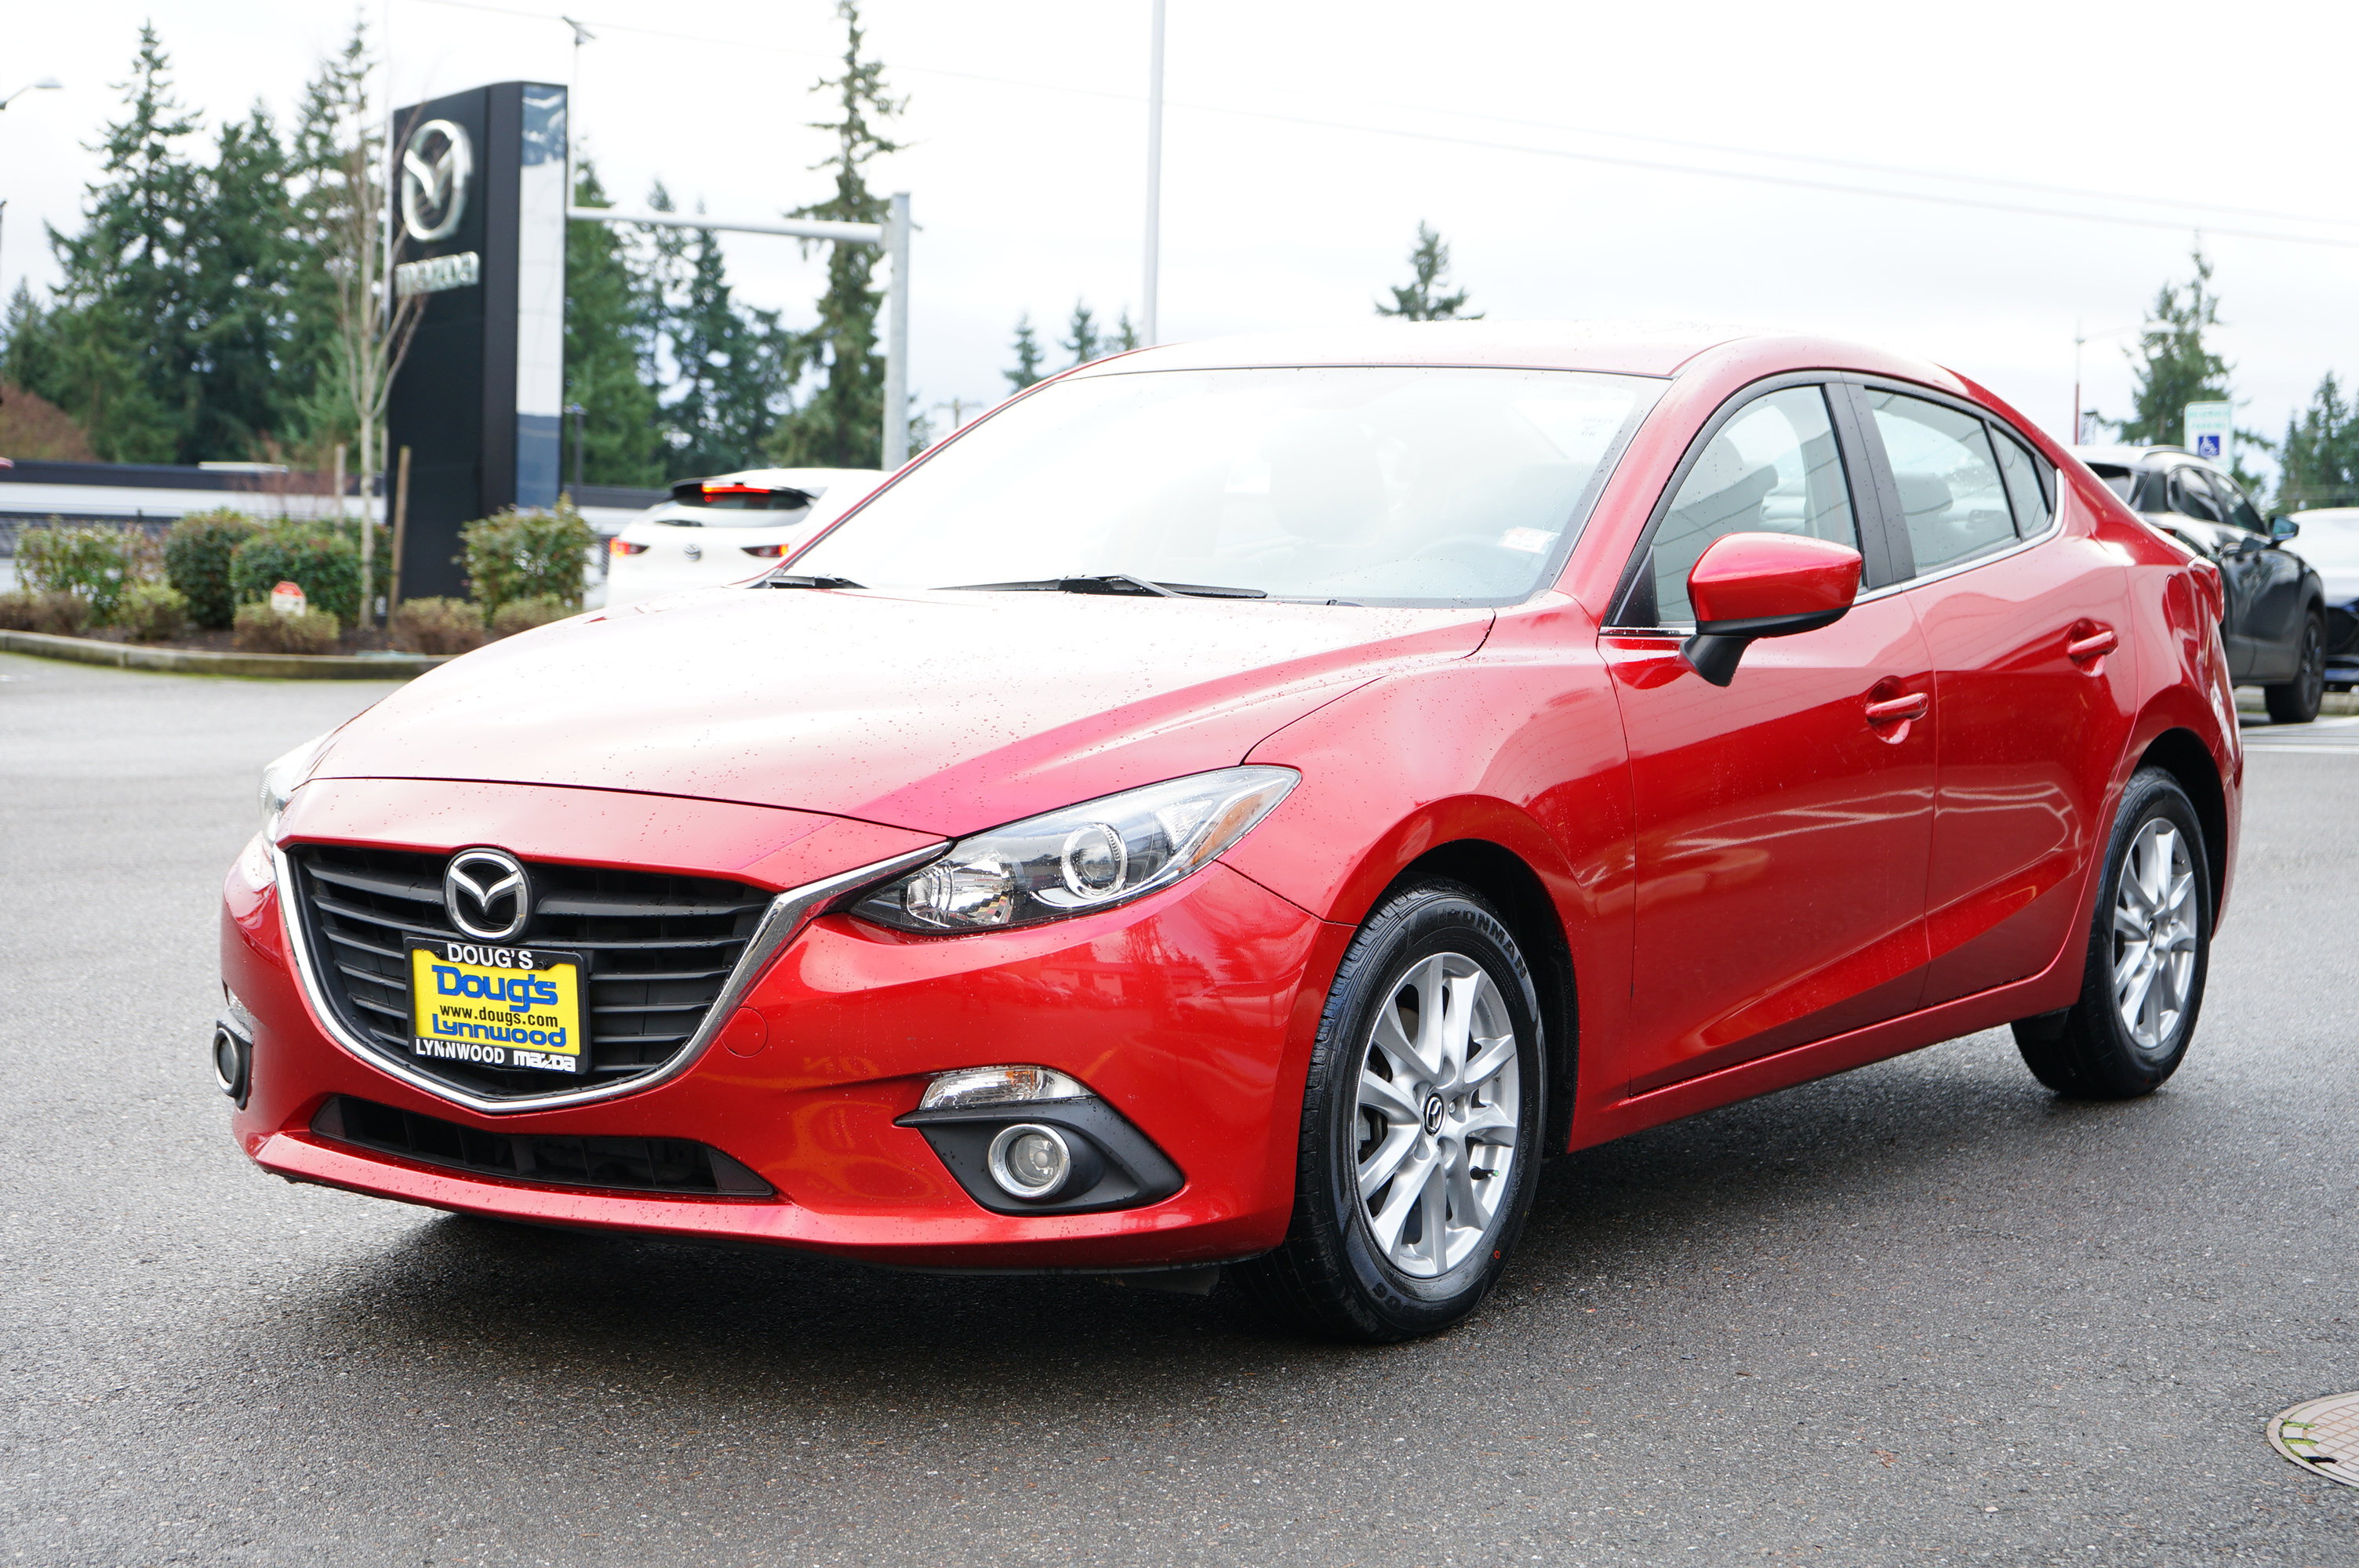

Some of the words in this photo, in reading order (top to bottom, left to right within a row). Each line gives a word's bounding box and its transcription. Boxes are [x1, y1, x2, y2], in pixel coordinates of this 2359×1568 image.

[447, 943, 533, 969] DOUG'S
[439, 1004, 558, 1028] www.dougs.com
[431, 1013, 567, 1047] Lynnwood
[416, 1038, 505, 1065] LYNNWOOD
